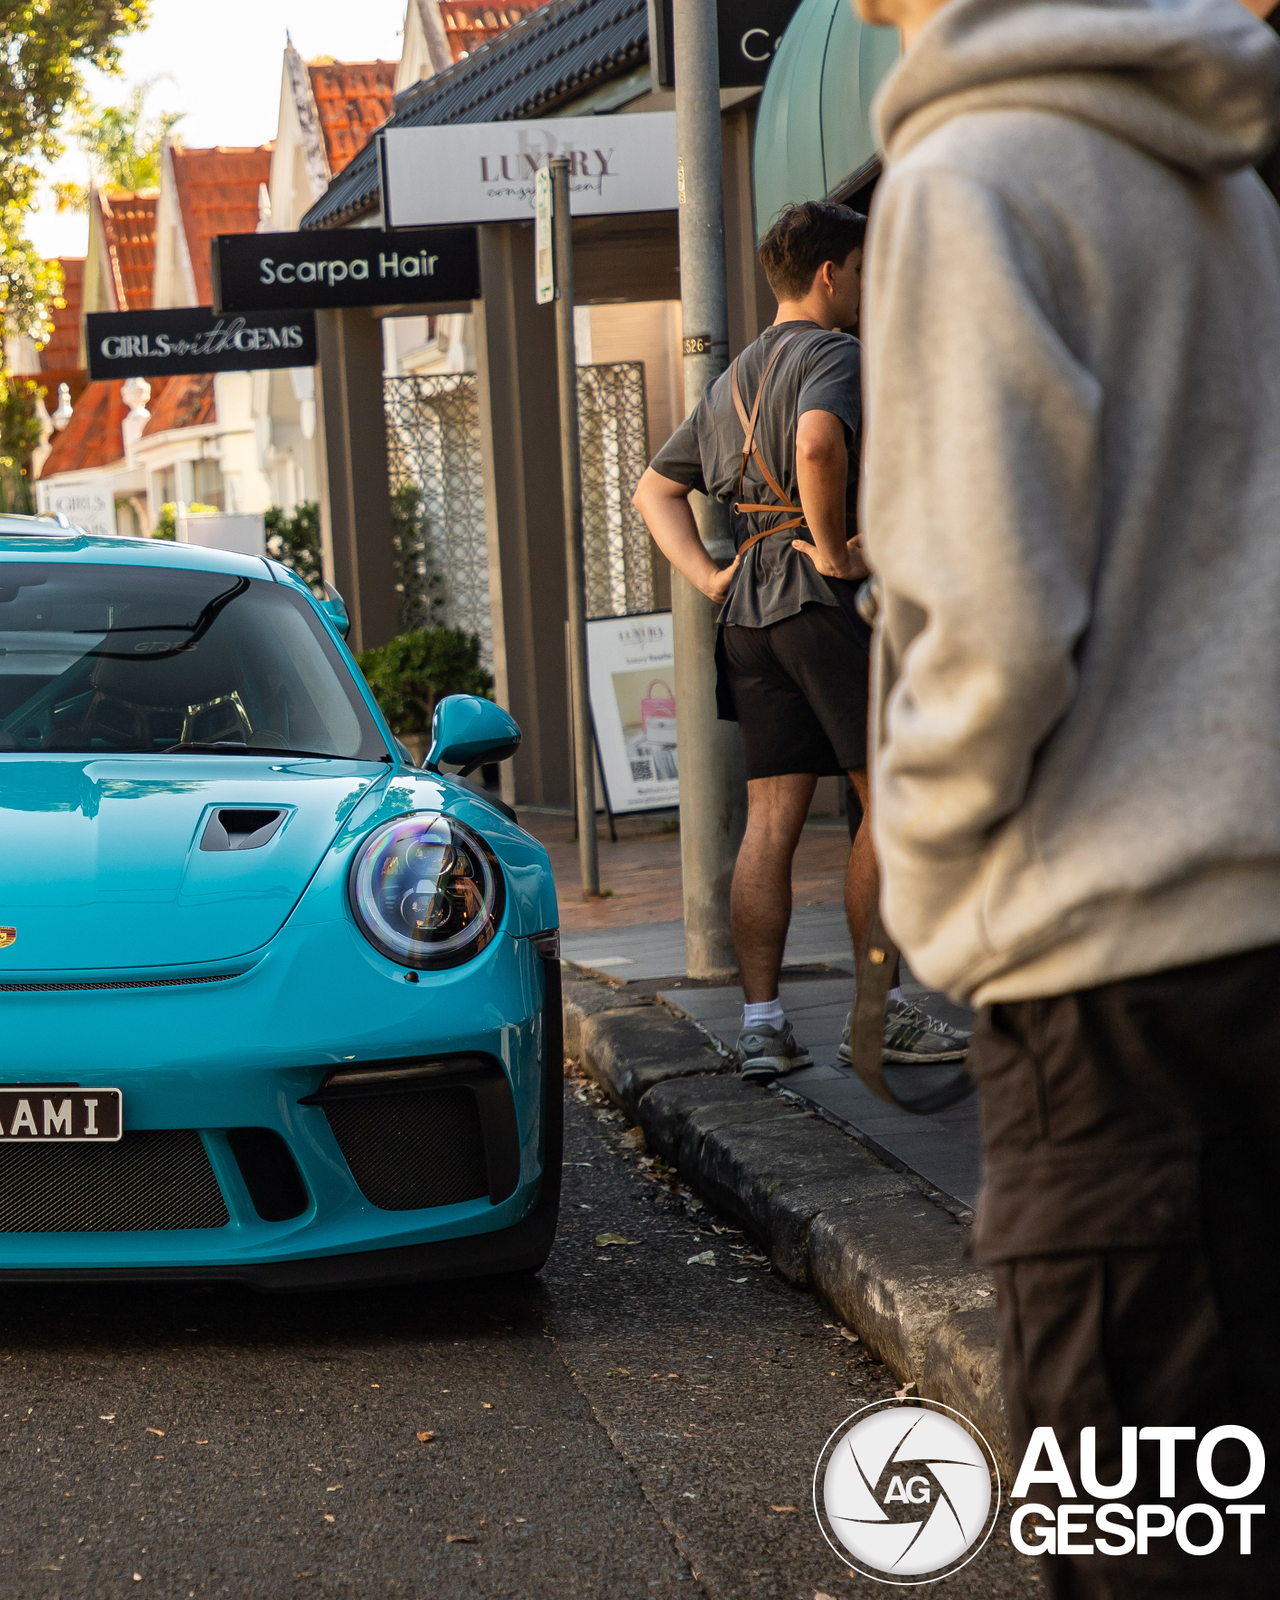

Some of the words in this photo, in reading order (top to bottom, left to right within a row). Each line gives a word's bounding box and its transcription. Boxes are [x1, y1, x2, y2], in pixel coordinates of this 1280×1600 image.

[259, 257, 370, 287] Scarpa
[378, 249, 439, 278] Hair
[100, 334, 171, 359] GIRLS
[233, 325, 304, 351] GEMS
